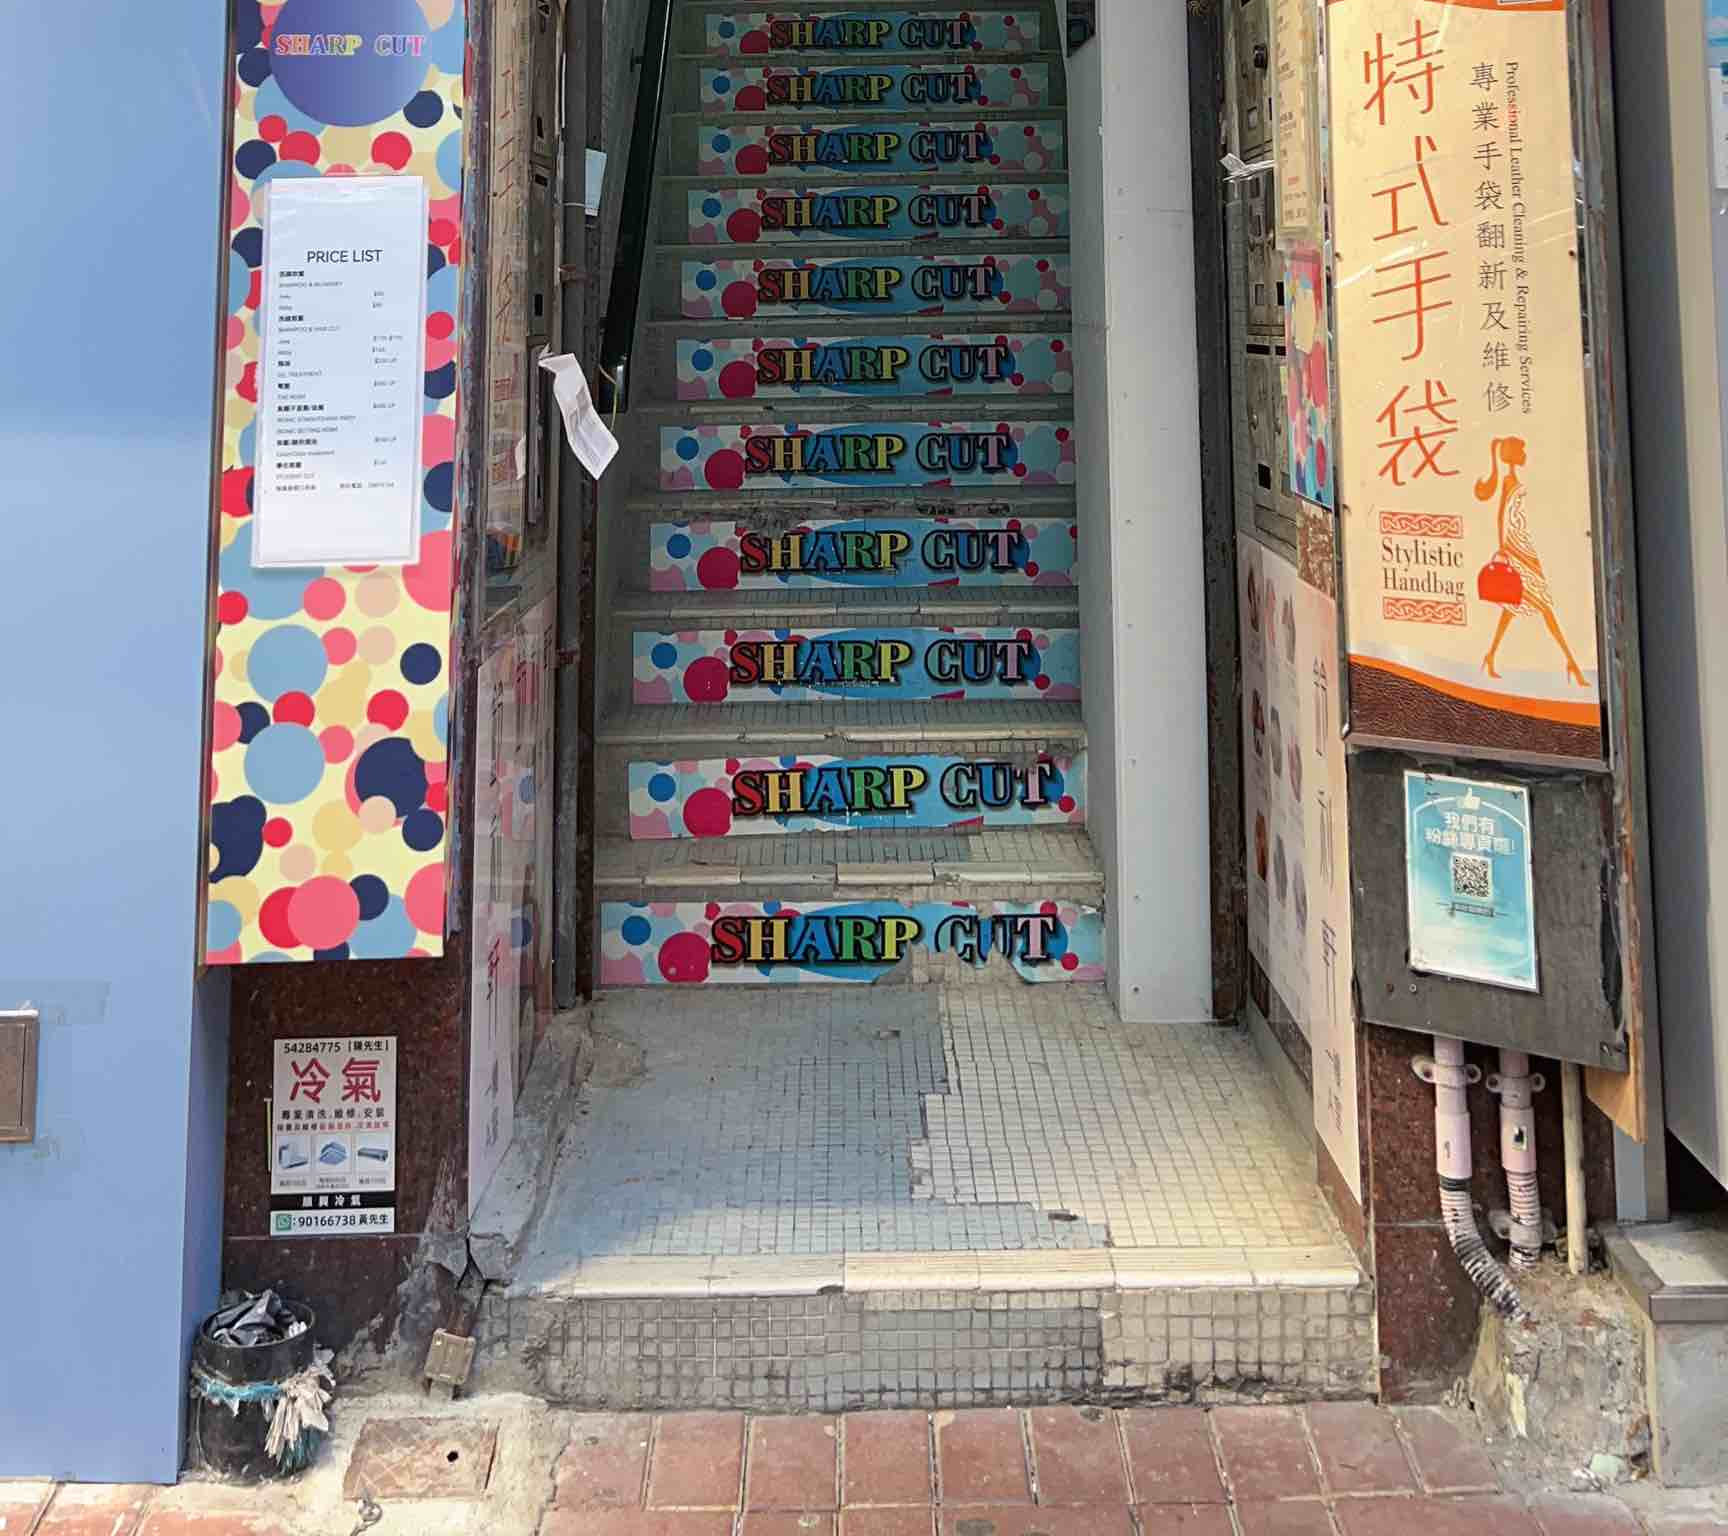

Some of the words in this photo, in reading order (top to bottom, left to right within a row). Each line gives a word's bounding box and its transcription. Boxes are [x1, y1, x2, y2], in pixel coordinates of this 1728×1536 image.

[274, 34, 362, 56] SHARP
[375, 34, 425, 56] CUT
[769, 19, 889, 49] SHARP
[899, 18, 967, 48] CUT
[767, 73, 892, 106] SHARP
[900, 72, 972, 103] CUT
[1505, 61, 1523, 144] Professional
[768, 132, 899, 166] SHARP
[909, 129, 983, 162] CUT
[1510, 147, 1525, 197] Leather
[761, 195, 898, 231] SHARP
[908, 193, 989, 227] CUT
[1511, 202, 1527, 264] Cleaning
[307, 250, 349, 263] PRICE
[353, 249, 383, 263] LIST
[1364, 18, 1460, 487] 特式手袋
[1470, 62, 1515, 413] 專業手袋翻新及維修
[758, 266, 901, 303] SHARP
[910, 264, 994, 301] CUT
[1515, 267, 1529, 281] &
[1513, 285, 1532, 352] Repairing
[757, 345, 909, 384] SHARP
[918, 343, 1008, 382] CUT
[1519, 355, 1534, 414] Services
[744, 434, 904, 474] SHARP
[915, 431, 1008, 471] CUT
[739, 531, 911, 574] SHARP
[921, 528, 1023, 570] CUT
[1381, 537, 1464, 569] Stylistic
[1382, 567, 1466, 601] Handbag
[730, 641, 912, 686] SHARP
[924, 639, 1030, 682] CUT
[732, 766, 928, 817] SHARP
[940, 762, 1051, 809] CUT
[711, 915, 921, 966] SHARP
[284, 1042, 340, 1054] 54284775
[290, 1057, 381, 1103] 冷氣
